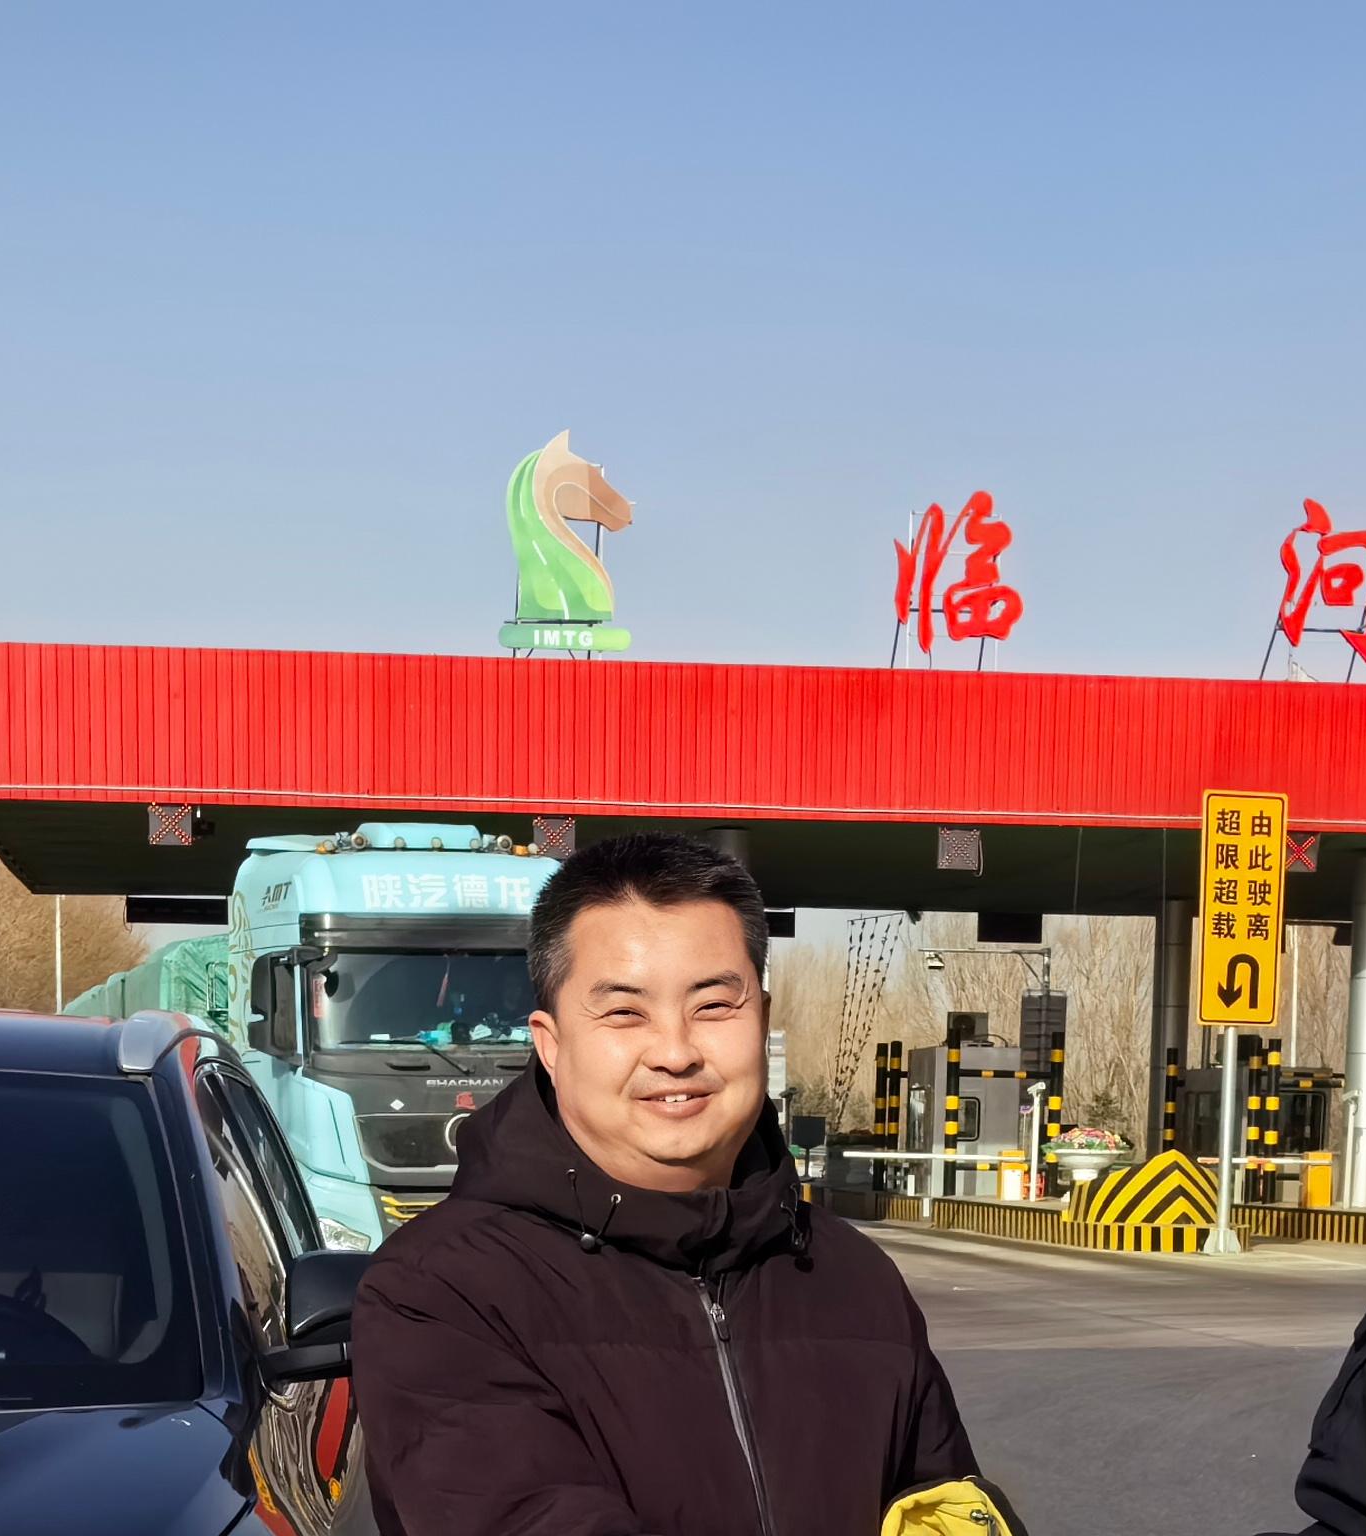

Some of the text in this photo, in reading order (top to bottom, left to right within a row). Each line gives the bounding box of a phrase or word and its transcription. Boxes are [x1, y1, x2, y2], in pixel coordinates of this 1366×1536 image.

[533, 629, 593, 648] IMTG
[361, 873, 533, 912] 陕汽德龙
[1211, 808, 1241, 940] 超限超载
[1246, 810, 1272, 941] 由此驶离
[426, 1079, 504, 1088] SHACMAN
